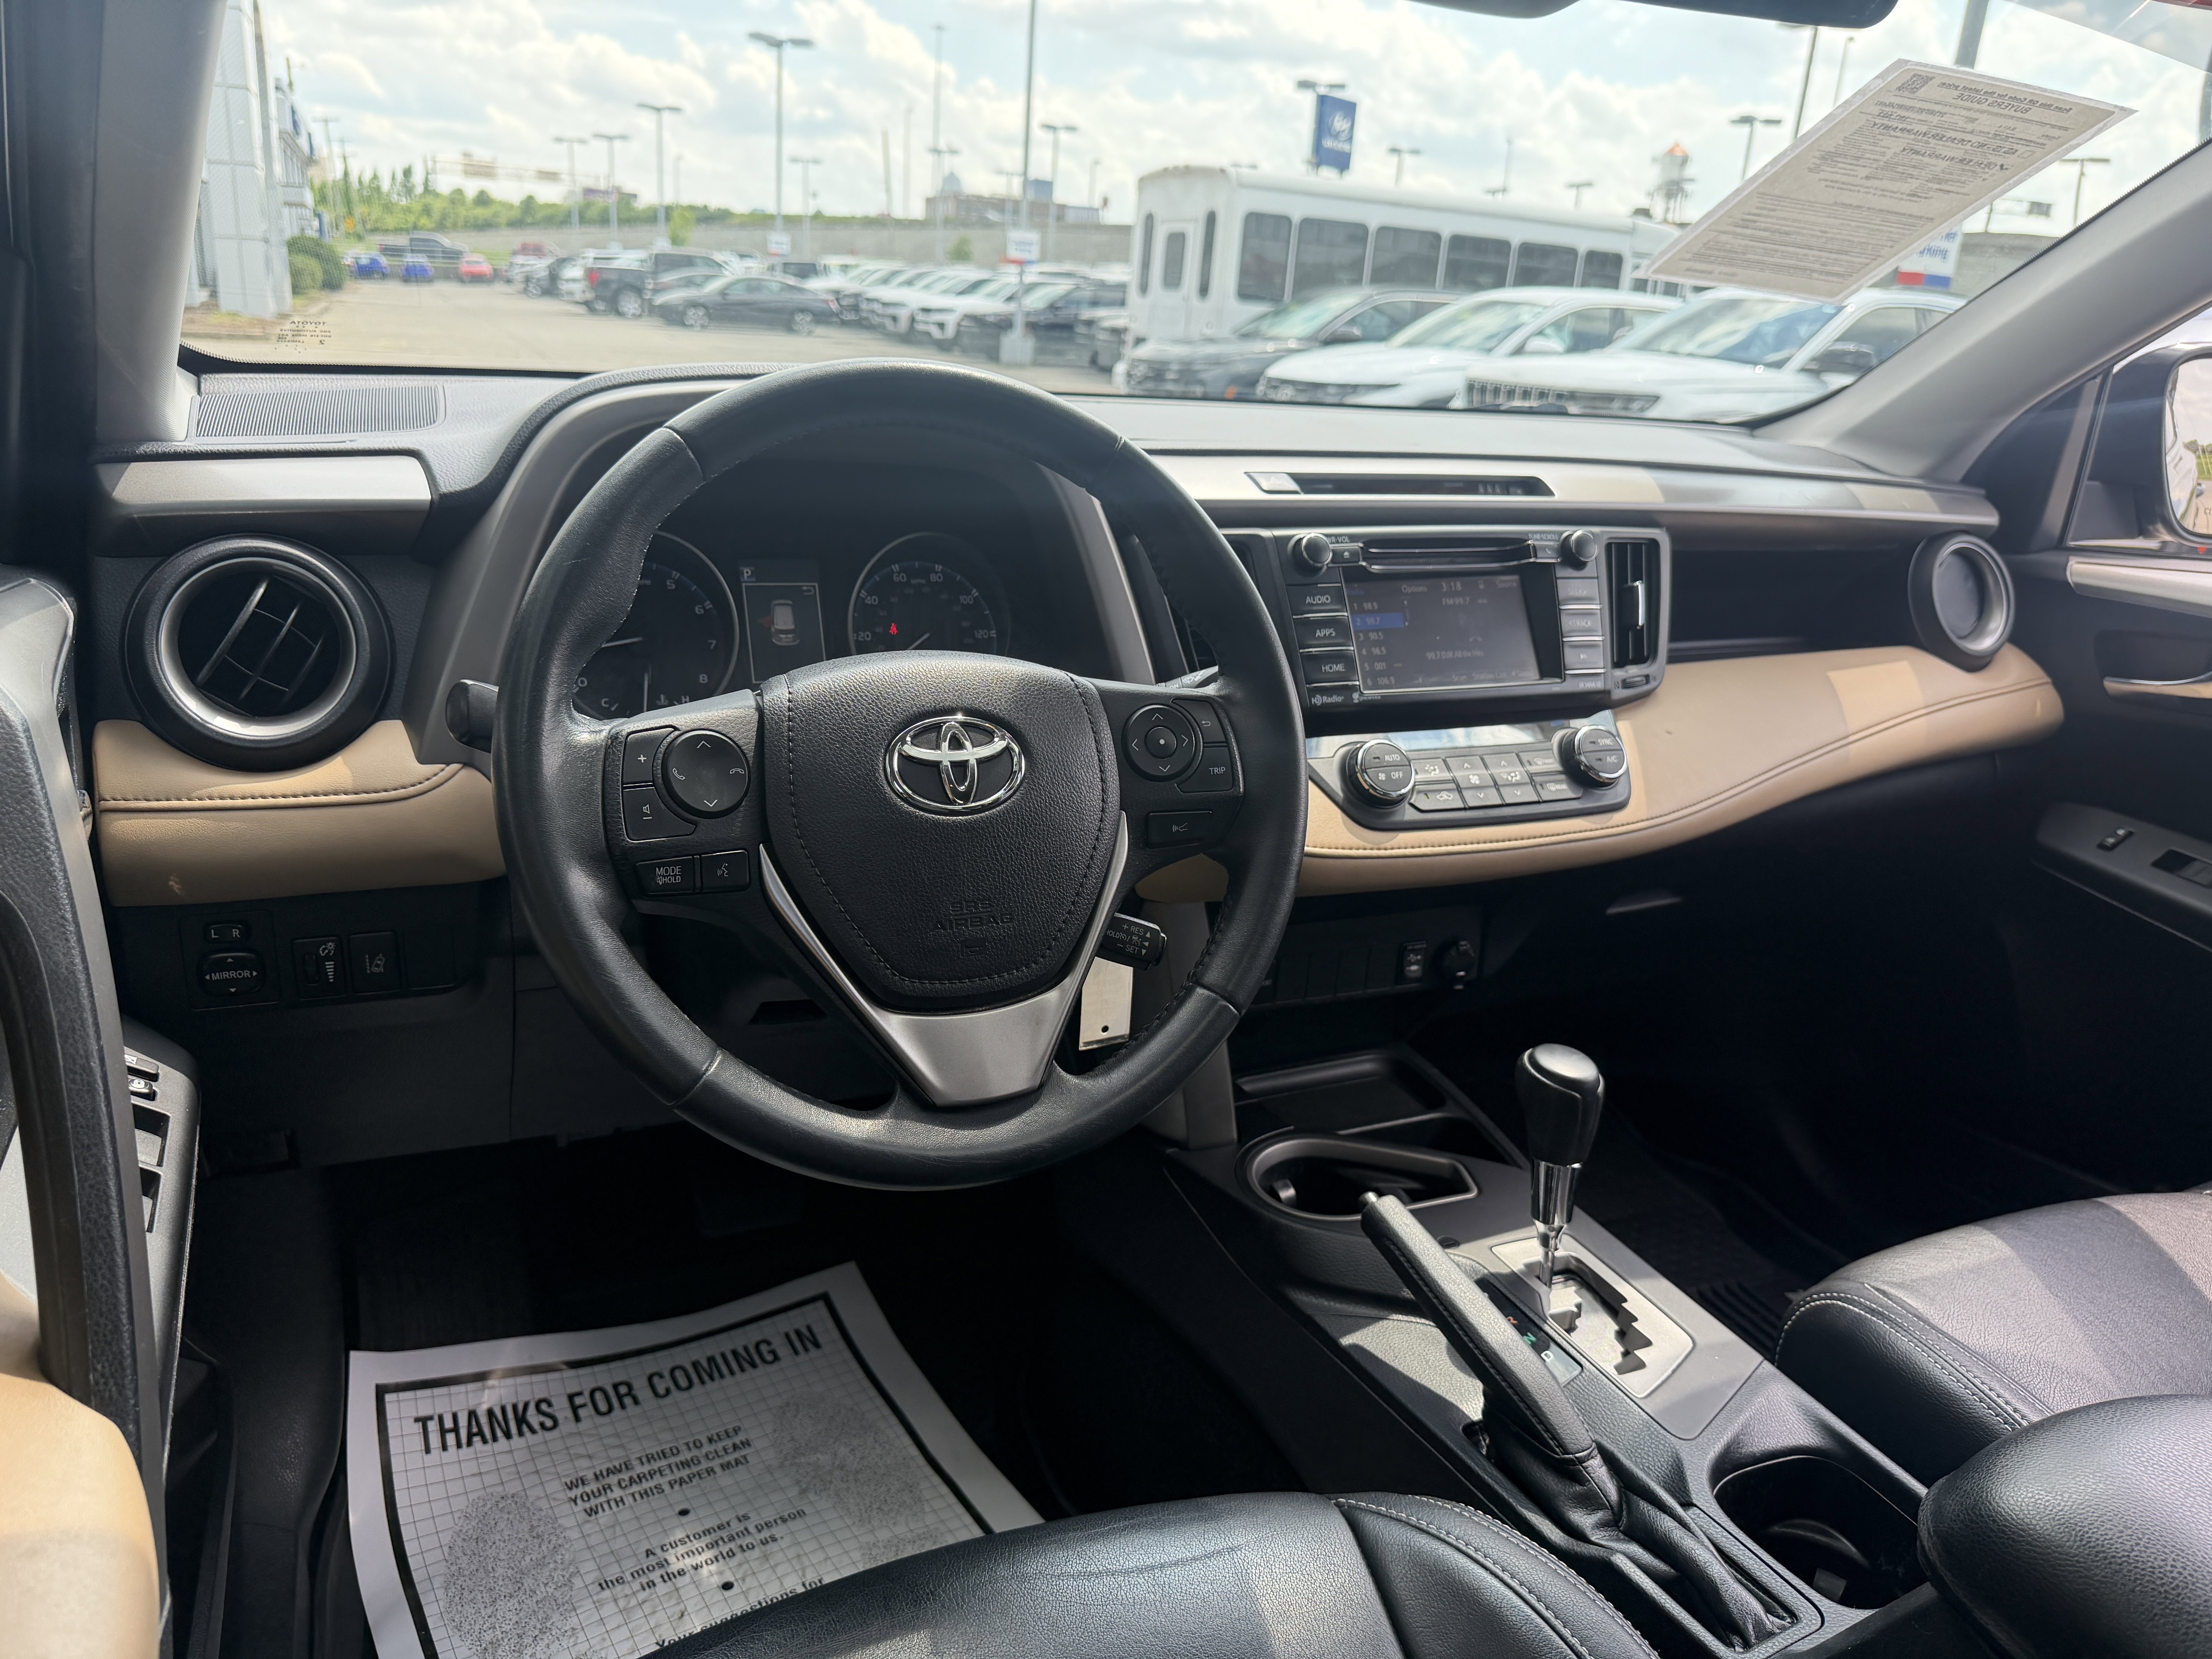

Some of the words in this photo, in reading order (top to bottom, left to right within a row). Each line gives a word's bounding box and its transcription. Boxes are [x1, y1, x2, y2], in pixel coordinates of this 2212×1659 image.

[742, 568, 751, 579] P
[893, 573, 906, 582] 60
[930, 573, 943, 582] 80
[666, 580, 675, 589] 5
[1401, 585, 1427, 594] Options
[1442, 582, 1462, 592] 3:18
[864, 596, 879, 605] 40
[959, 595, 974, 605] 100
[1306, 595, 1331, 604] AUDIO
[694, 604, 704, 614] 6
[1363, 602, 1379, 611] 98.9
[1366, 617, 1380, 625] 99.7
[858, 632, 871, 641] 20
[975, 630, 989, 639] 120
[1316, 629, 1336, 637] APPS
[1369, 632, 1384, 641] 90.5
[708, 639, 717, 649] 7
[1371, 647, 1386, 656] 96.5
[1321, 663, 1346, 673] HOME
[699, 674, 708, 684] 8
[1377, 677, 1395, 686] 106.9
[1597, 738, 1615, 746] SYNC
[1209, 767, 1226, 775] TRIP
[1391, 771, 1403, 780] OFF
[656, 866, 682, 876] MODE
[950, 900, 992, 914] SRS
[934, 913, 1014, 932] AIRBAG
[211, 929, 219, 938] L
[232, 929, 240, 938] R
[1130, 926, 1144, 935] RES
[1125, 945, 1139, 954] SET
[211, 970, 251, 980] MIRROR
[1523, 1332, 1537, 1346] N
[414, 1396, 560, 1454] THANKS
[567, 1380, 642, 1423] FOR
[647, 1338, 781, 1398] COMING
[783, 1324, 822, 1356] IN
[564, 1475, 591, 1491] WE
[594, 1458, 634, 1482] HAVE
[636, 1445, 681, 1467] TRIED
[683, 1438, 703, 1452] TO
[707, 1425, 742, 1445] KEEP
[569, 1483, 615, 1506] YOUR
[618, 1455, 701, 1490] CARPETING
[705, 1437, 752, 1461] CLEAN
[584, 1496, 626, 1517] WITH
[630, 1483, 666, 1503] THIS
[668, 1465, 717, 1490] PAPER
[720, 1453, 750, 1472] MAT
[644, 1549, 657, 1559] A
[660, 1521, 733, 1553] customer
[736, 1511, 752, 1523] is
[598, 1575, 626, 1592] the
[630, 1558, 672, 1580] most
[673, 1528, 752, 1562] important
[755, 1508, 807, 1534] person
[640, 1579, 657, 1591] in
[659, 1568, 687, 1584] the
[691, 1547, 736, 1571] world
[738, 1540, 756, 1553] to
[759, 1532, 785, 1546] us.
[802, 1577, 826, 1590] for
